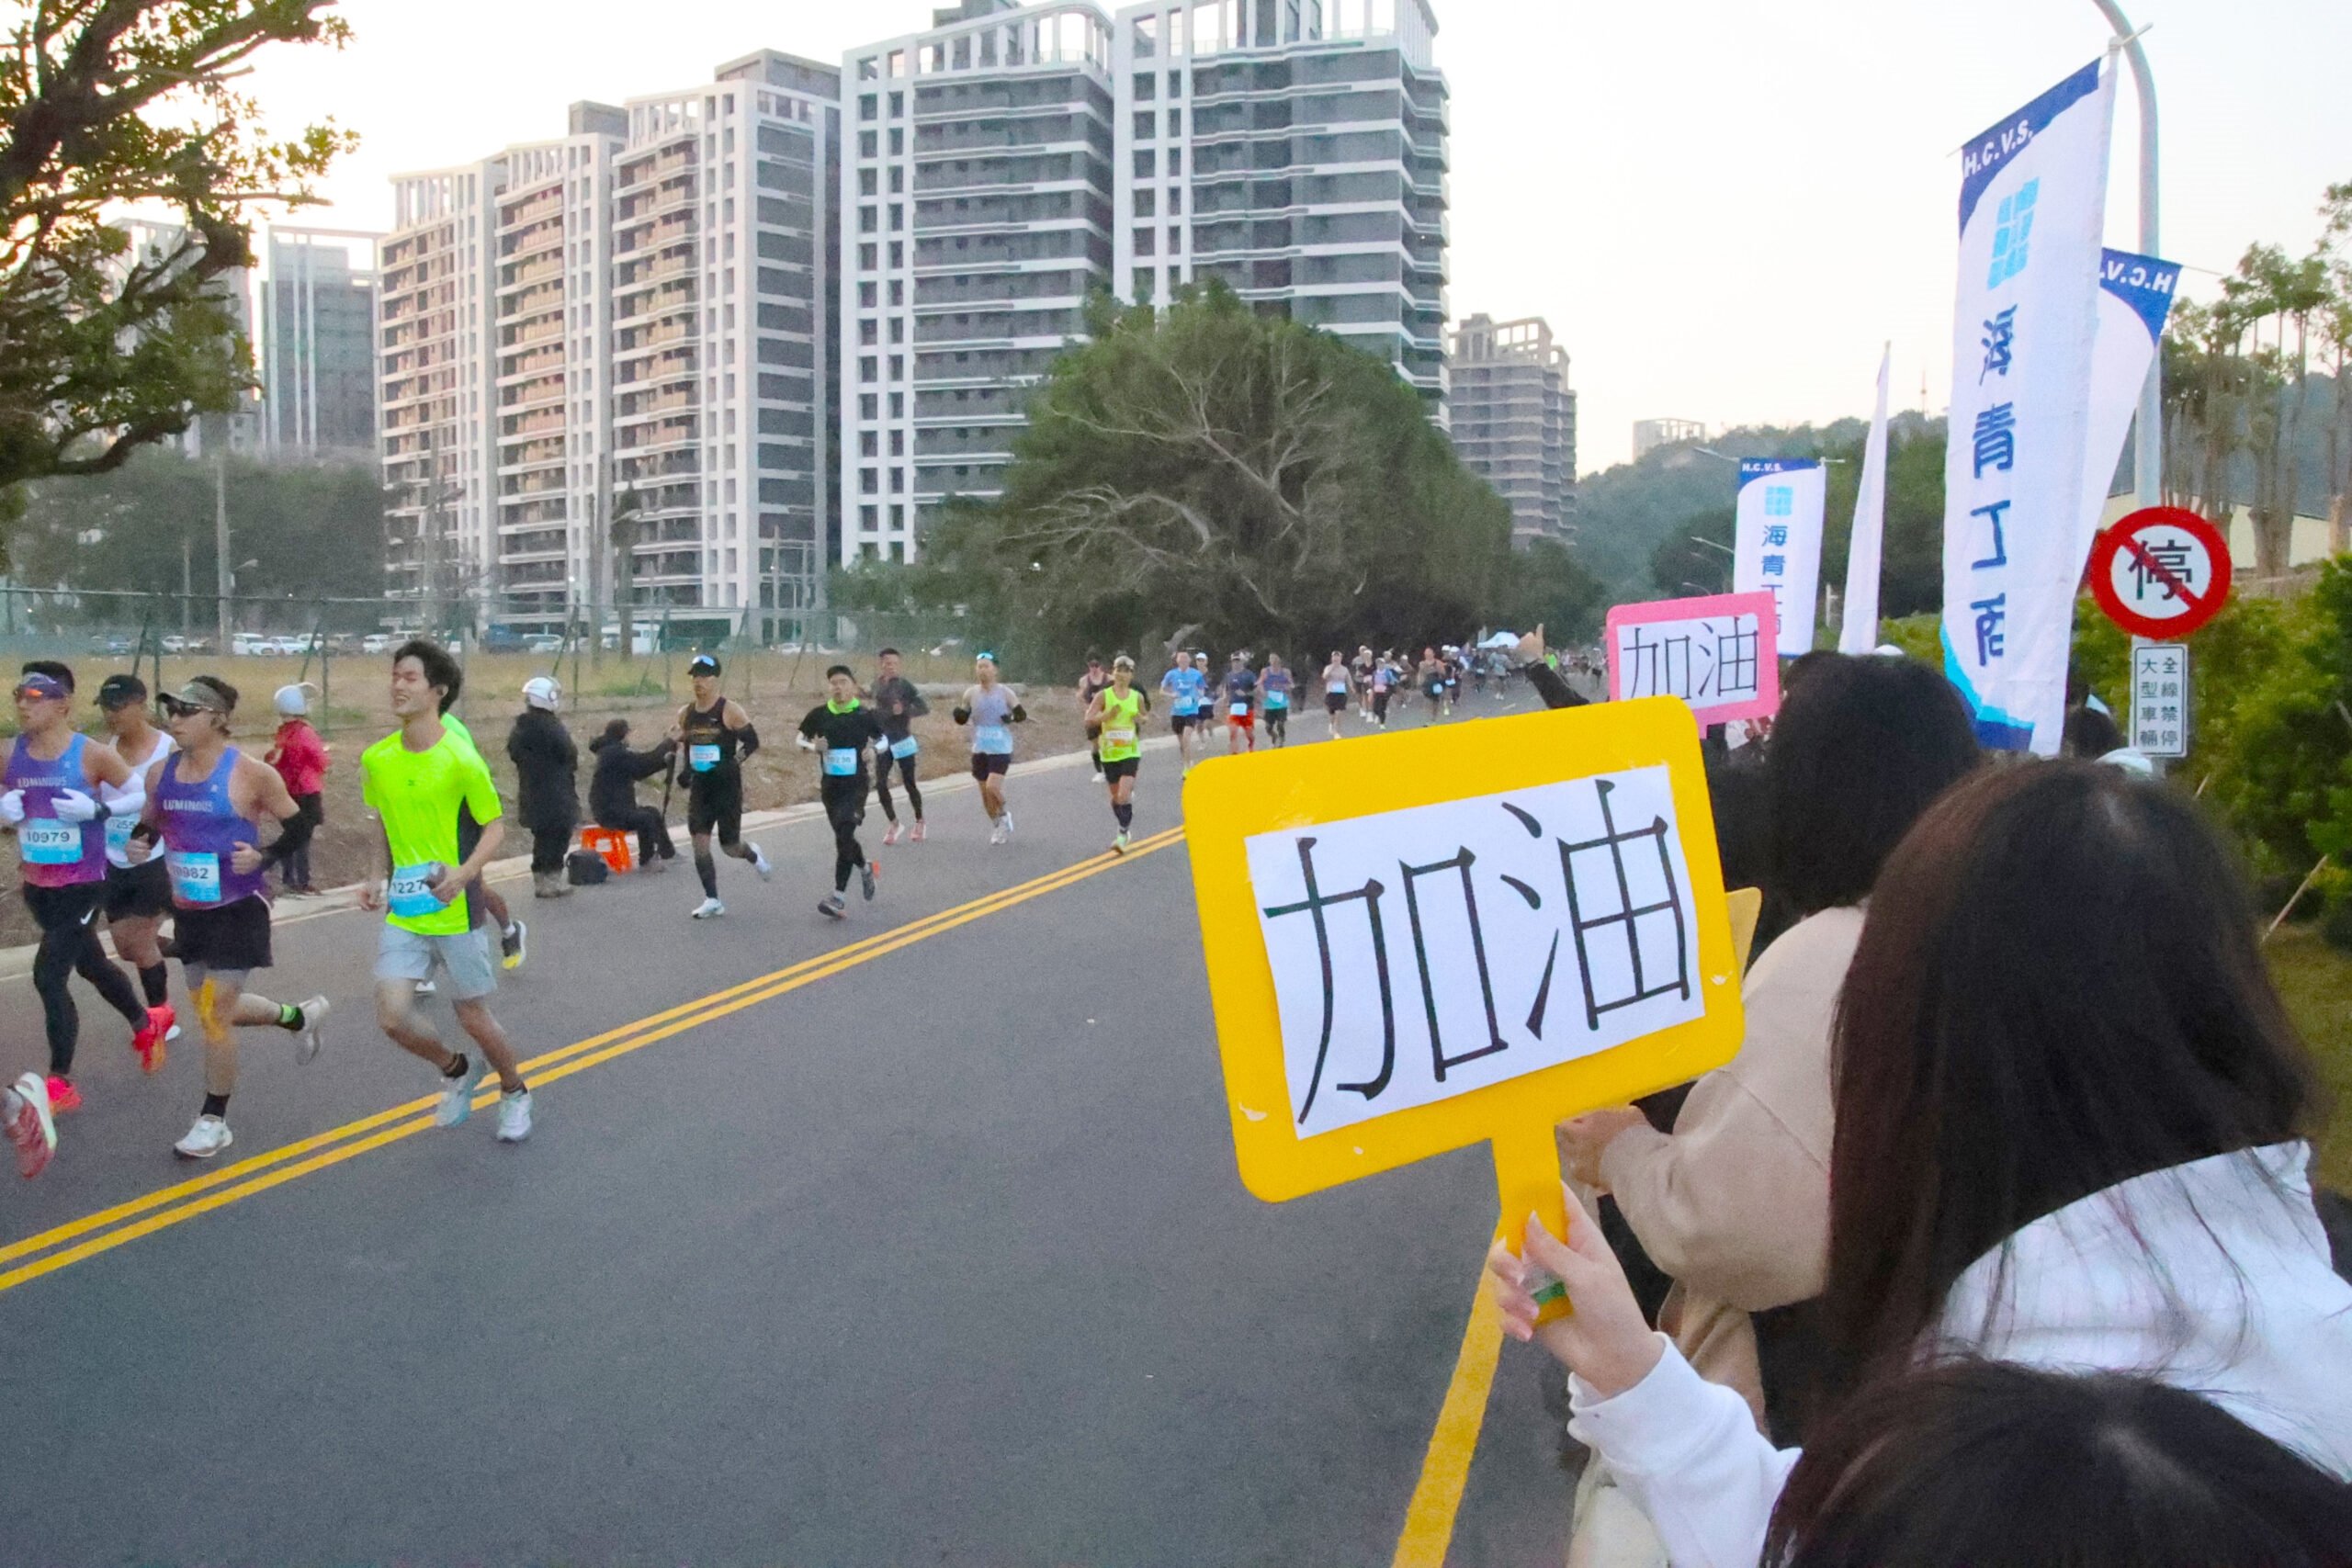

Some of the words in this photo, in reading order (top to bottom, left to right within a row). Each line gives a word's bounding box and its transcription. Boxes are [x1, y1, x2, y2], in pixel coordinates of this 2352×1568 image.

[1964, 119, 2033, 178] H.C.V.S.
[1742, 463, 1783, 472] H.C.V.S.
[2128, 539, 2193, 600] 停
[1623, 616, 1758, 700] 加油
[2141, 659, 2158, 746] 大型車輛
[2161, 657, 2178, 746] 全線禁停
[163, 799, 213, 812] LUMINOUS
[27, 831, 71, 843] 10979
[1263, 779, 1690, 1125] 加油
